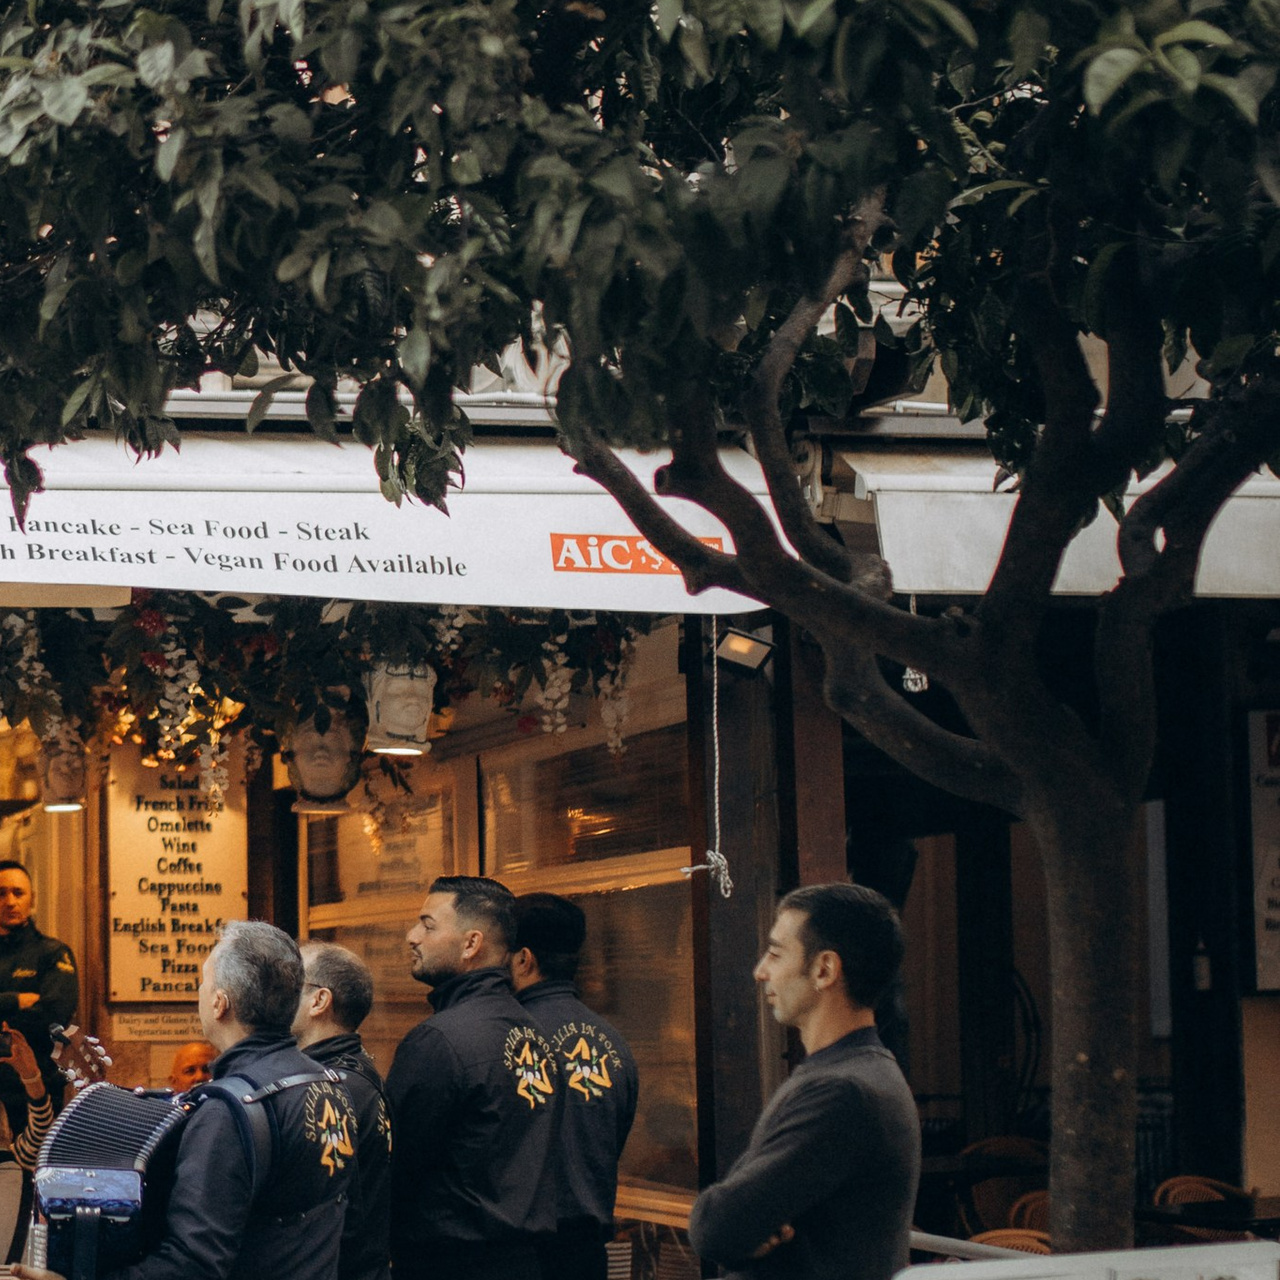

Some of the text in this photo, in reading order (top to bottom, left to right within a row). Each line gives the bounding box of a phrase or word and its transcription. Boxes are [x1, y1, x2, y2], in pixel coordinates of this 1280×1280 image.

[148, 518, 195, 536] Sea
[204, 519, 271, 540] Food
[296, 521, 371, 542] Steak
[26, 542, 158, 566] Breakfast
[183, 546, 264, 572] Vegan
[272, 552, 339, 574] Food
[347, 553, 468, 577] Available
[555, 536, 633, 570] AiC
[160, 774, 200, 790] Salad
[135, 794, 185, 812] French
[147, 816, 212, 833] Omelette
[161, 836, 198, 854] Wine
[156, 856, 203, 874] Coffee
[137, 877, 223, 897] Cappuccino
[160, 896, 200, 913] Pasta
[112, 917, 167, 937] English
[138, 938, 170, 954] Sea
[160, 958, 199, 974] Pizza
